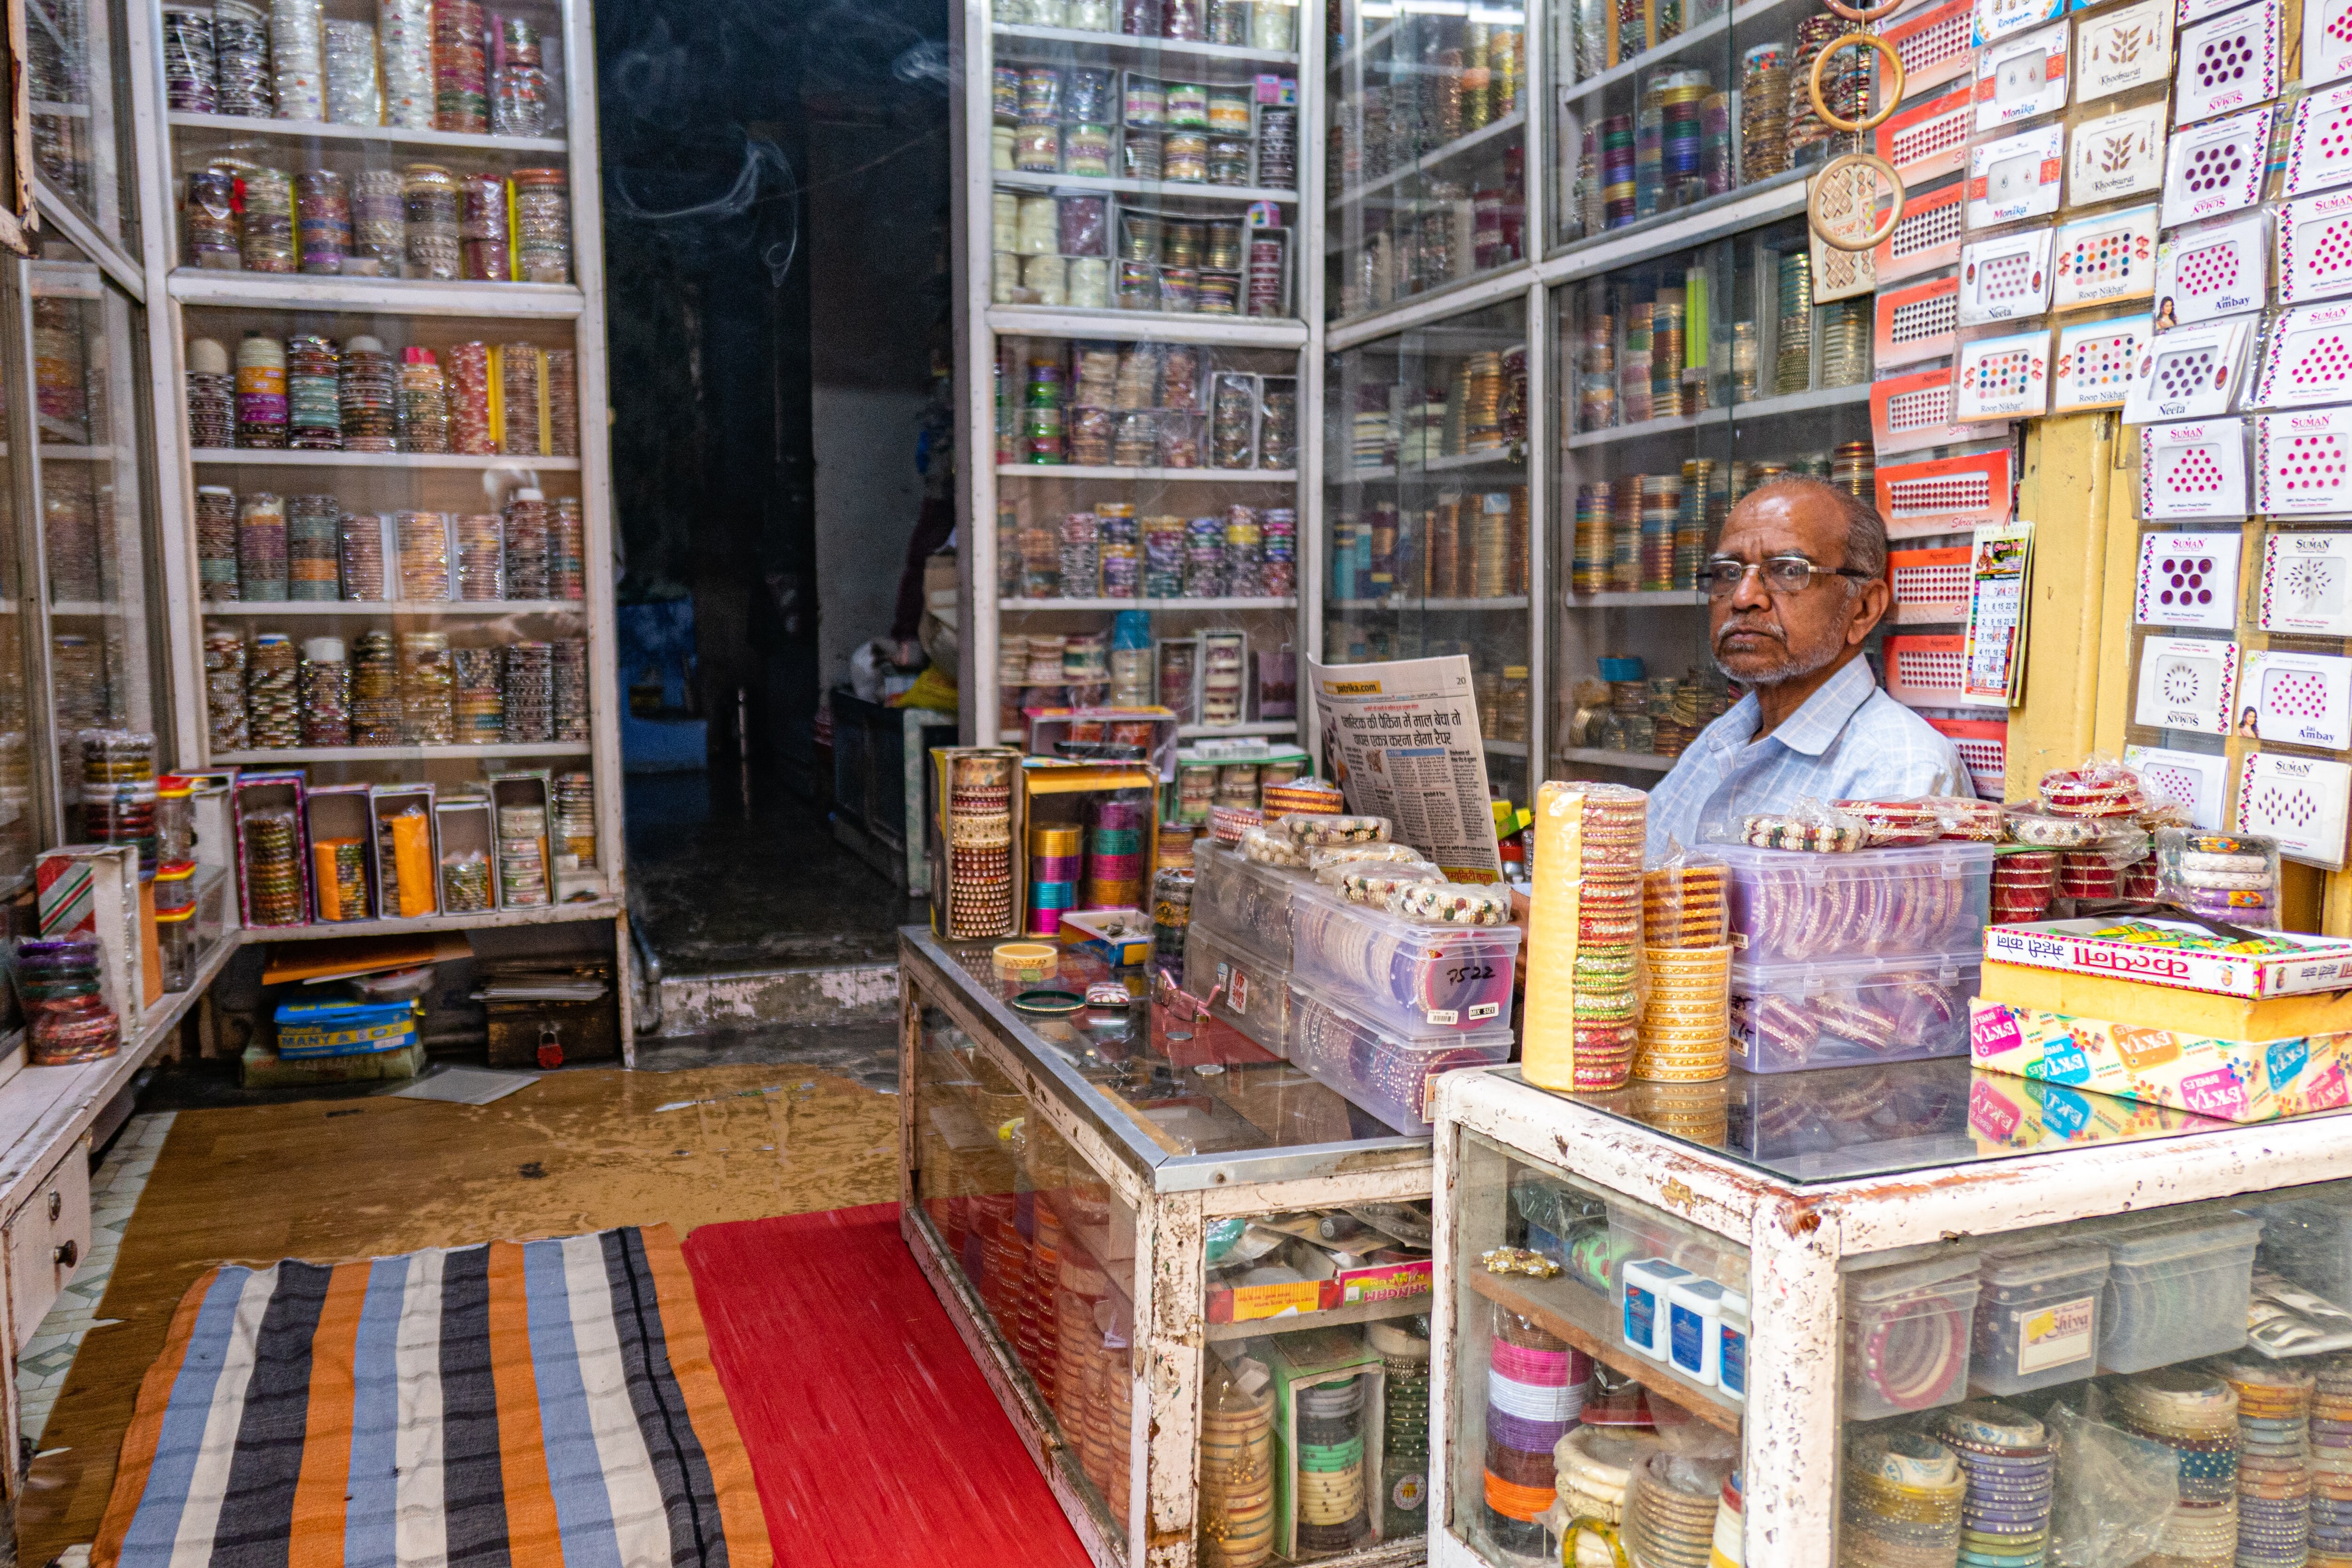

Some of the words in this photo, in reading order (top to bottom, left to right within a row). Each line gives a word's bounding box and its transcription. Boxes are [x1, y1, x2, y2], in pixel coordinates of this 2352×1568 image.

[1998, 12, 2032, 28] Roopam
[2098, 67, 2140, 87] Khoobsurat
[2209, 94, 2243, 111] SUMAN
[2331, 90, 2352, 102] SUM
[2002, 104, 2035, 120] Monika
[2092, 175, 2134, 192] Khoobsurat
[1993, 206, 2027, 220] Monika
[2193, 198, 2226, 214] SUMAN
[2079, 290, 2098, 300] Roop
[2099, 285, 2124, 295] Nikhar
[2215, 296, 2250, 310] Ambay
[1988, 307, 2012, 318] Neeta
[2310, 308, 2347, 322] SUMAN
[2079, 394, 2098, 403] Roop
[2099, 390, 2126, 400] Nikhar
[1981, 404, 1997, 413] Roop
[1999, 402, 2022, 411] Nikhar
[2158, 404, 2185, 416] Neeta
[2291, 416, 2329, 428] SUMAN
[1949, 425, 1971, 436] Shree
[2170, 428, 2203, 438] SUMAN
[1952, 517, 1973, 528] Shree
[2172, 539, 2205, 549] SUMAN
[2296, 539, 2330, 549] SUMAN
[1337, 682, 1377, 693] patrika.com
[1342, 713, 1366, 730] प्लास्टिक
[1366, 713, 1377, 729] की
[1377, 712, 1402, 730] पैकिंग
[1402, 712, 1412, 728] में
[1413, 713, 1432, 729] माल
[1433, 709, 1451, 727] बेचा
[1451, 709, 1462, 726] तो
[2168, 715, 2199, 726] SUMAN
[1369, 732, 1388, 747] एकत्र
[1389, 732, 1411, 747] करना
[1413, 731, 1433, 747] होगा
[1434, 729, 1452, 745] रैपर
[2298, 729, 2335, 743] Ambay
[2275, 761, 2311, 773] SUMAN
[1972, 779, 1990, 790] hree
[1997, 935, 2024, 954] कोन
[2028, 940, 2064, 961] मेहंदी
[2073, 946, 2191, 981] कल्पना
[1446, 966, 1496, 986] 7522
[1973, 1020, 2017, 1045] EKTA
[2120, 1030, 2173, 1055] EKTA
[2182, 1074, 2220, 1090] BANGLES
[2187, 1085, 2243, 1110] EKTA
[1364, 1284, 1428, 1302] SANGAM
